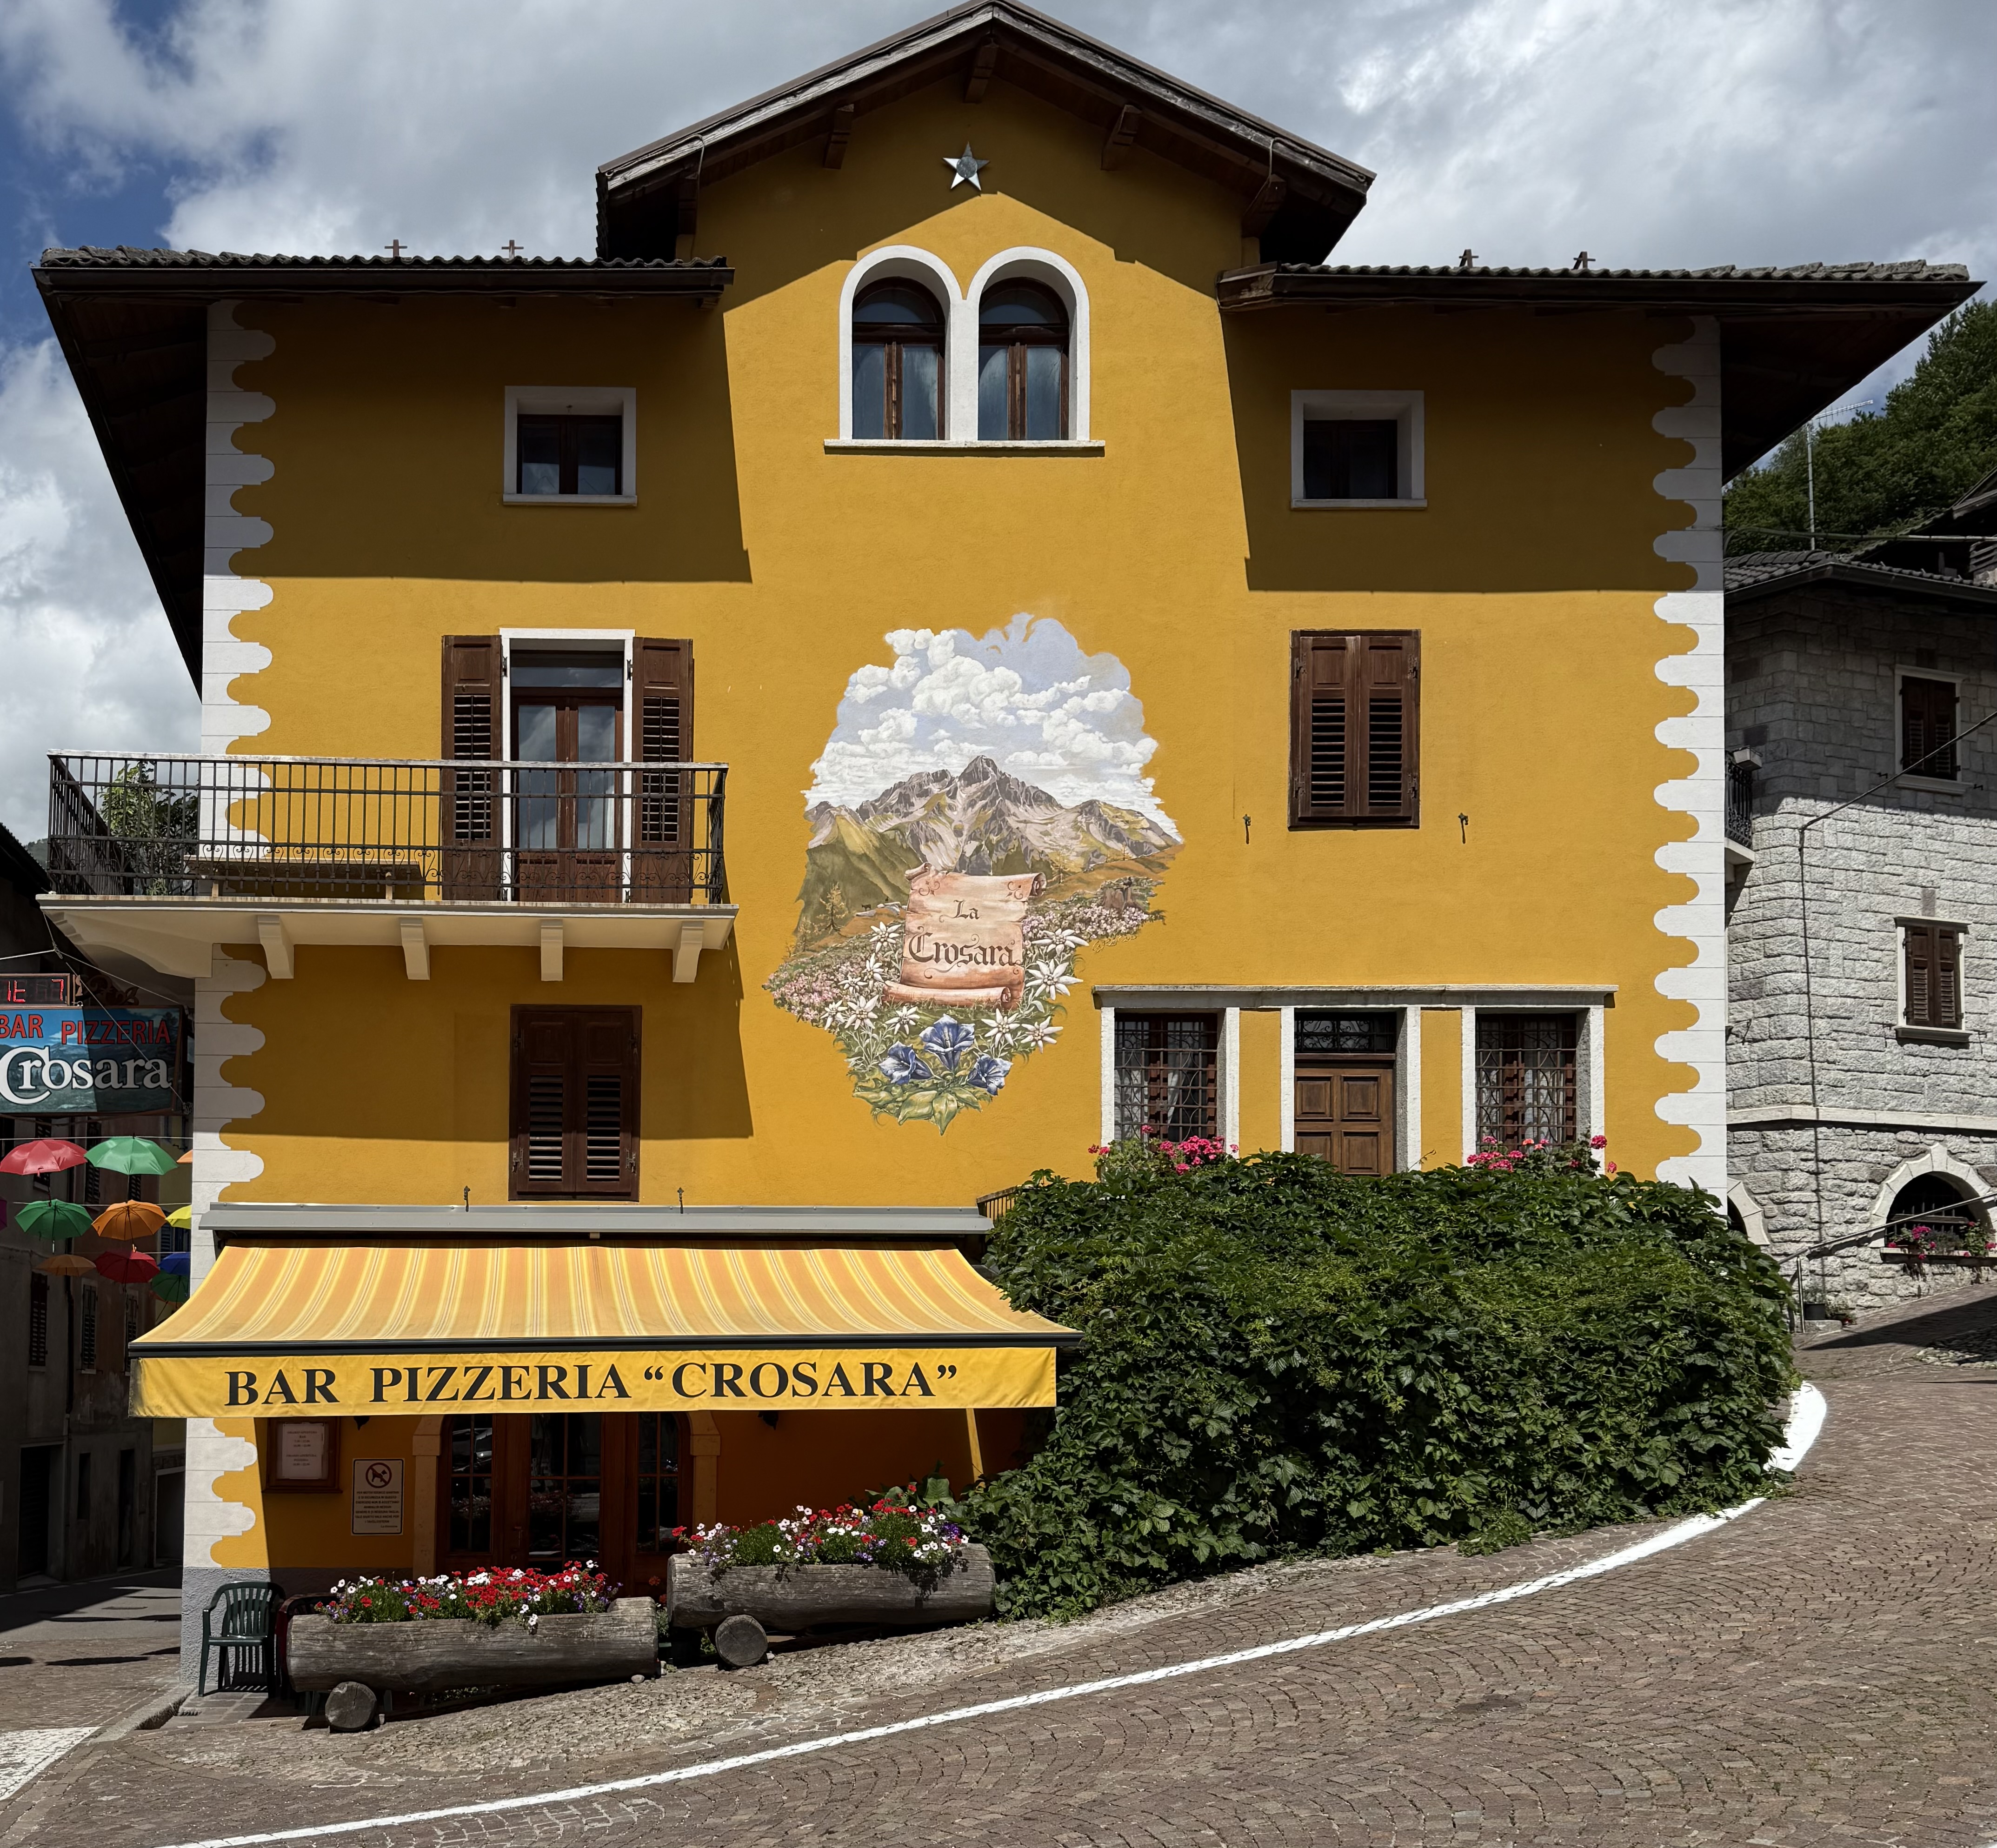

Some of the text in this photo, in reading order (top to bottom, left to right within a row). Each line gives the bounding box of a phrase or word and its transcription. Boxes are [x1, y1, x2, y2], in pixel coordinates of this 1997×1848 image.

[939, 899, 980, 922] La
[908, 926, 1022, 978] Crosara
[0, 1014, 171, 1045] BAR PIZZERIA
[0, 1045, 172, 1105] Crosara
[224, 1369, 340, 1406] BAR
[369, 1363, 632, 1403] PIZZERIA
